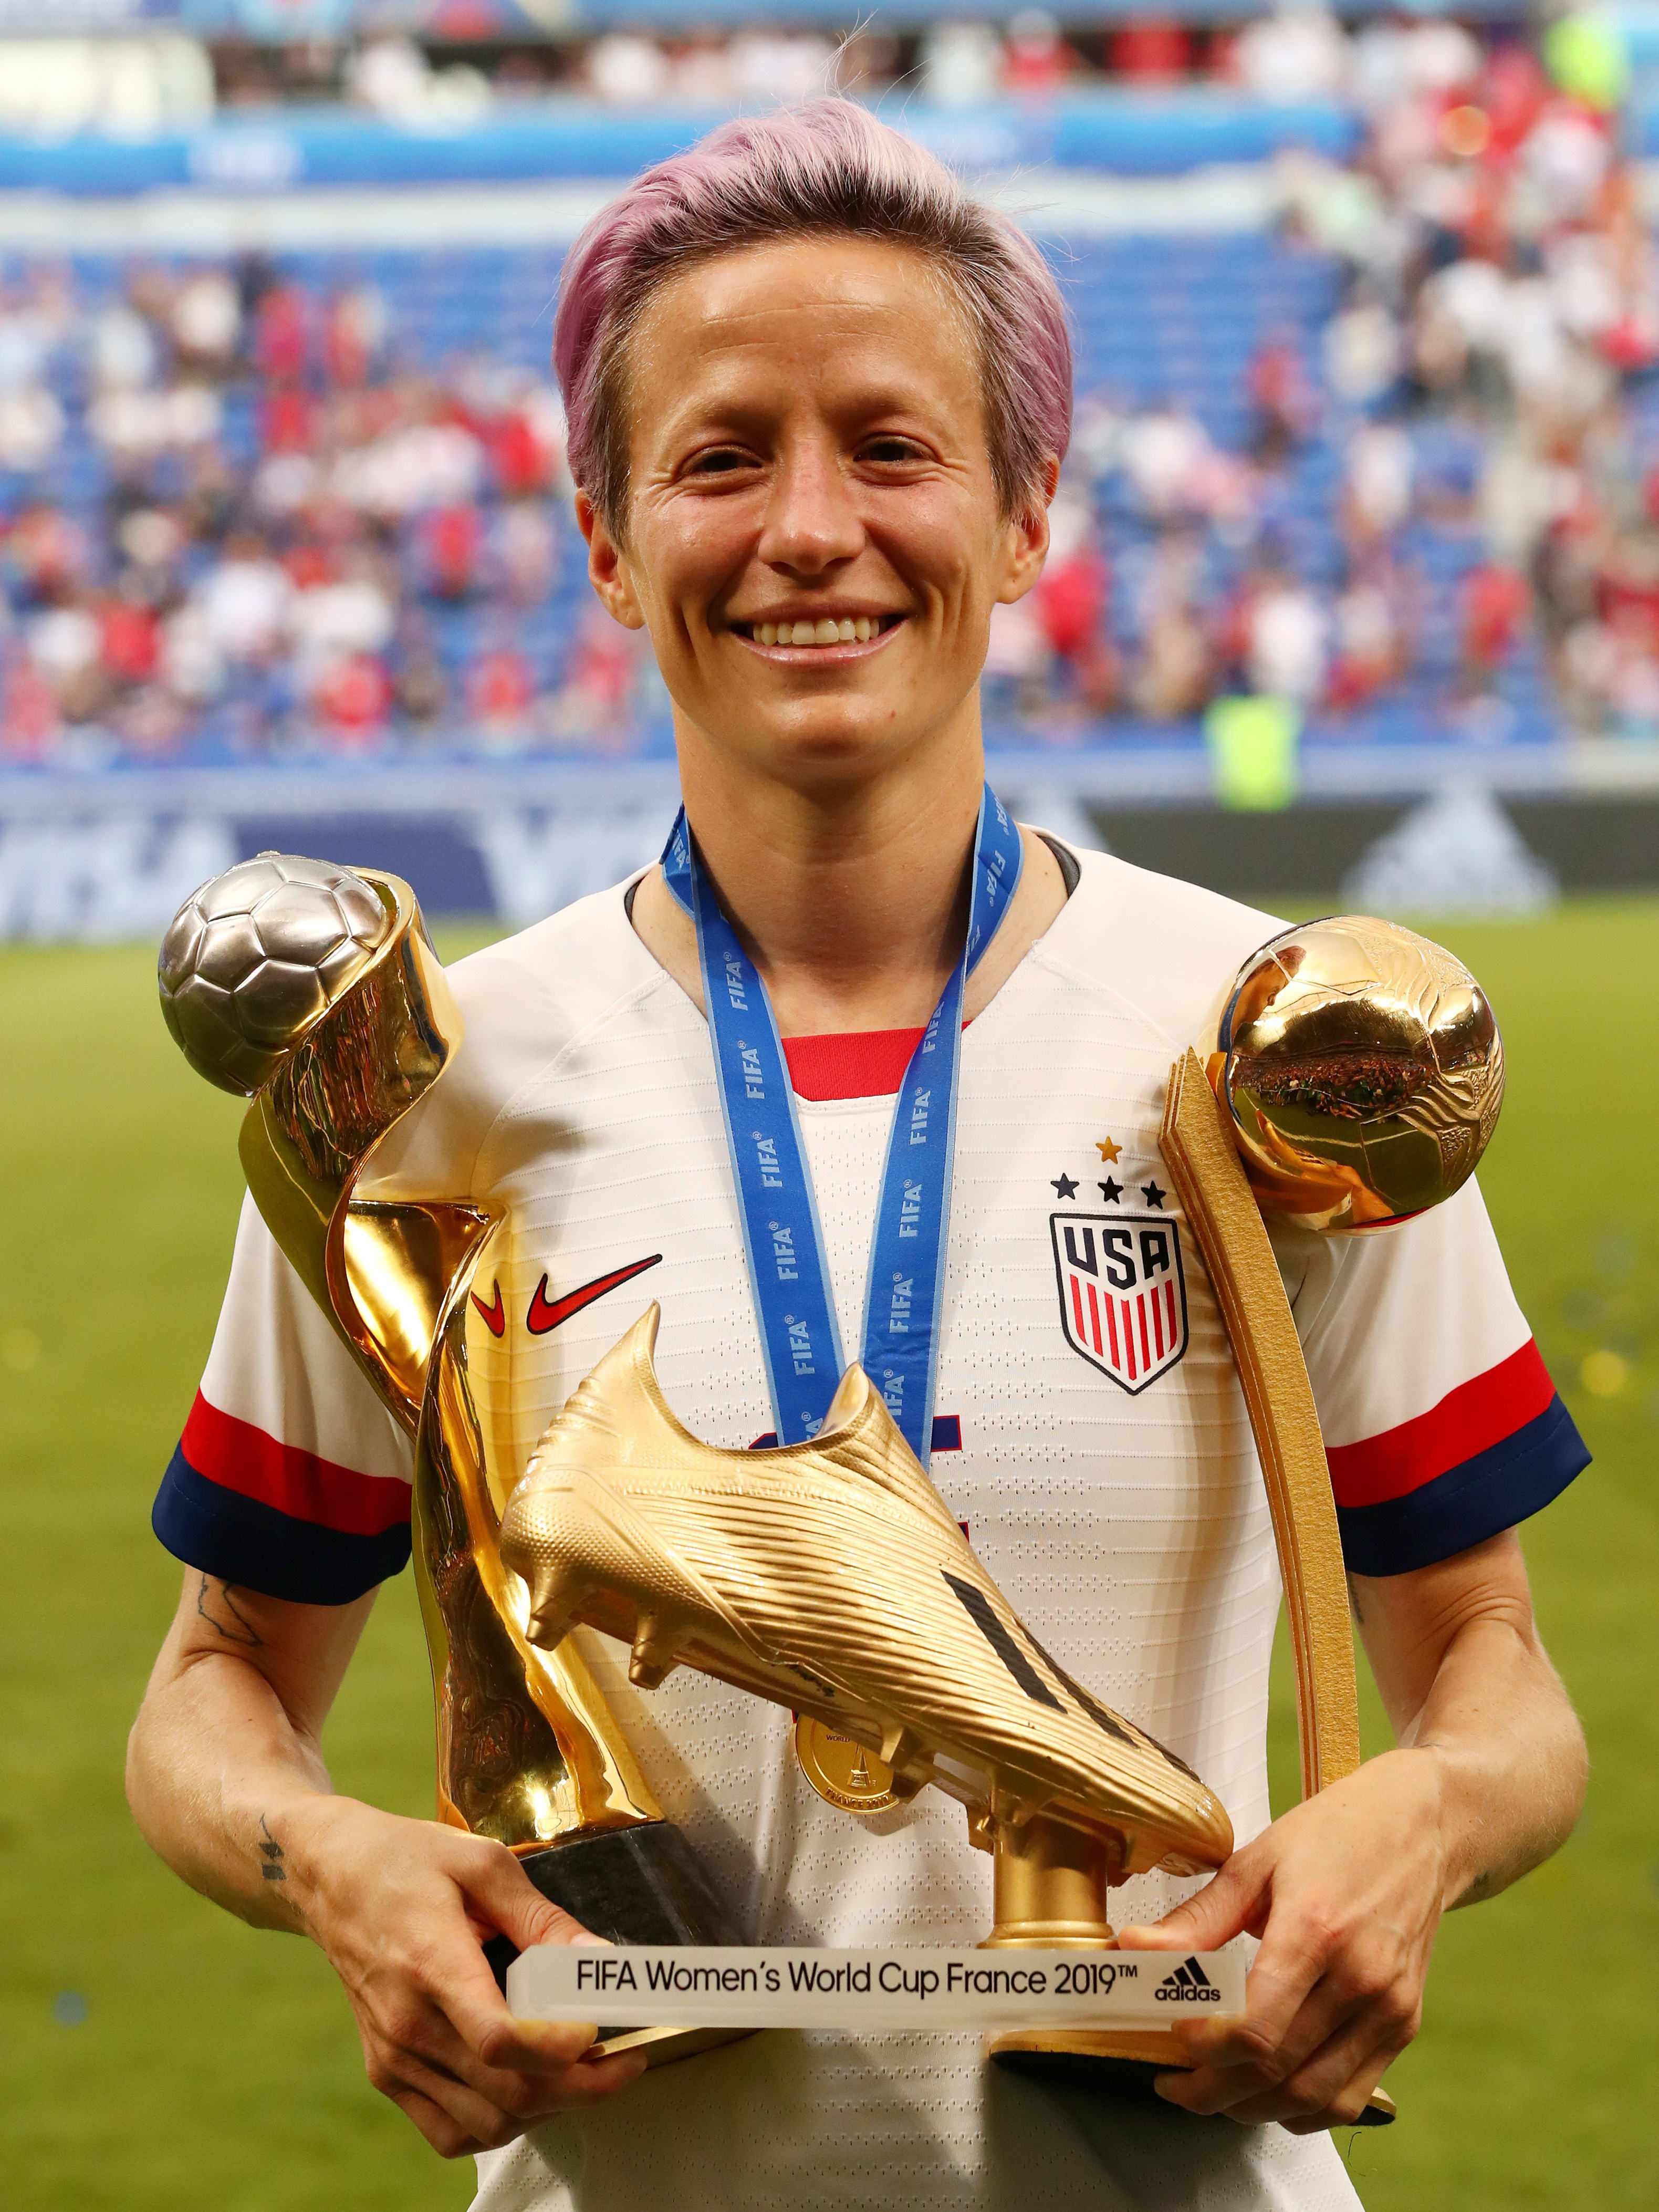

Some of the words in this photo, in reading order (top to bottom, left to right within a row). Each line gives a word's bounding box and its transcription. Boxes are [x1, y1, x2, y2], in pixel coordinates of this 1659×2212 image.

[1063, 1227, 1170, 1290] USA
[578, 1960, 637, 1990] FIFA
[788, 1961, 871, 1992] World
[879, 1962, 940, 2000] Cup
[947, 1962, 1047, 1994] France
[1154, 1985, 1221, 2002] adidas
